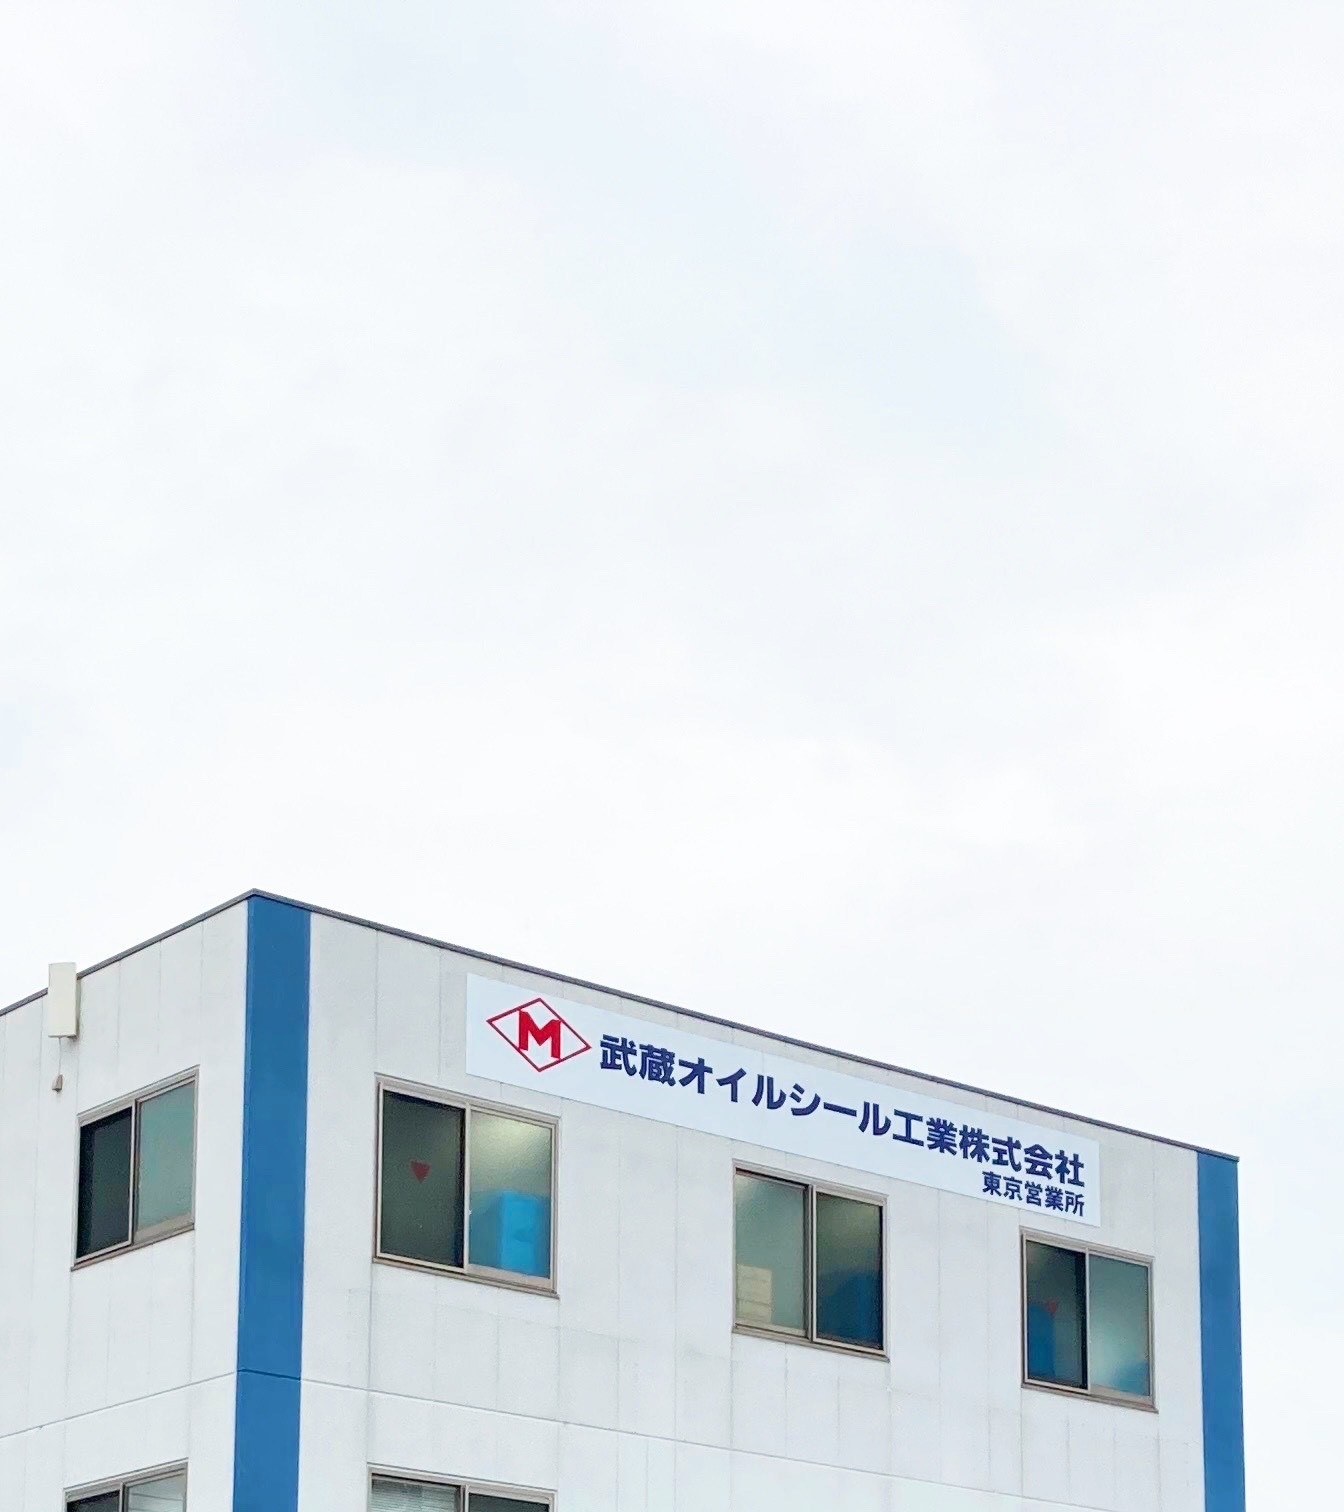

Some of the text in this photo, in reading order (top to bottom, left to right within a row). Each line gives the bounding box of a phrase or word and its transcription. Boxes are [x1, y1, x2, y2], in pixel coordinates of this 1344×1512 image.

[518, 1009, 561, 1060] M
[600, 1033, 1085, 1187] 武蔵オイルシール工業株式会社
[982, 1170, 1085, 1217] 東京営業所
